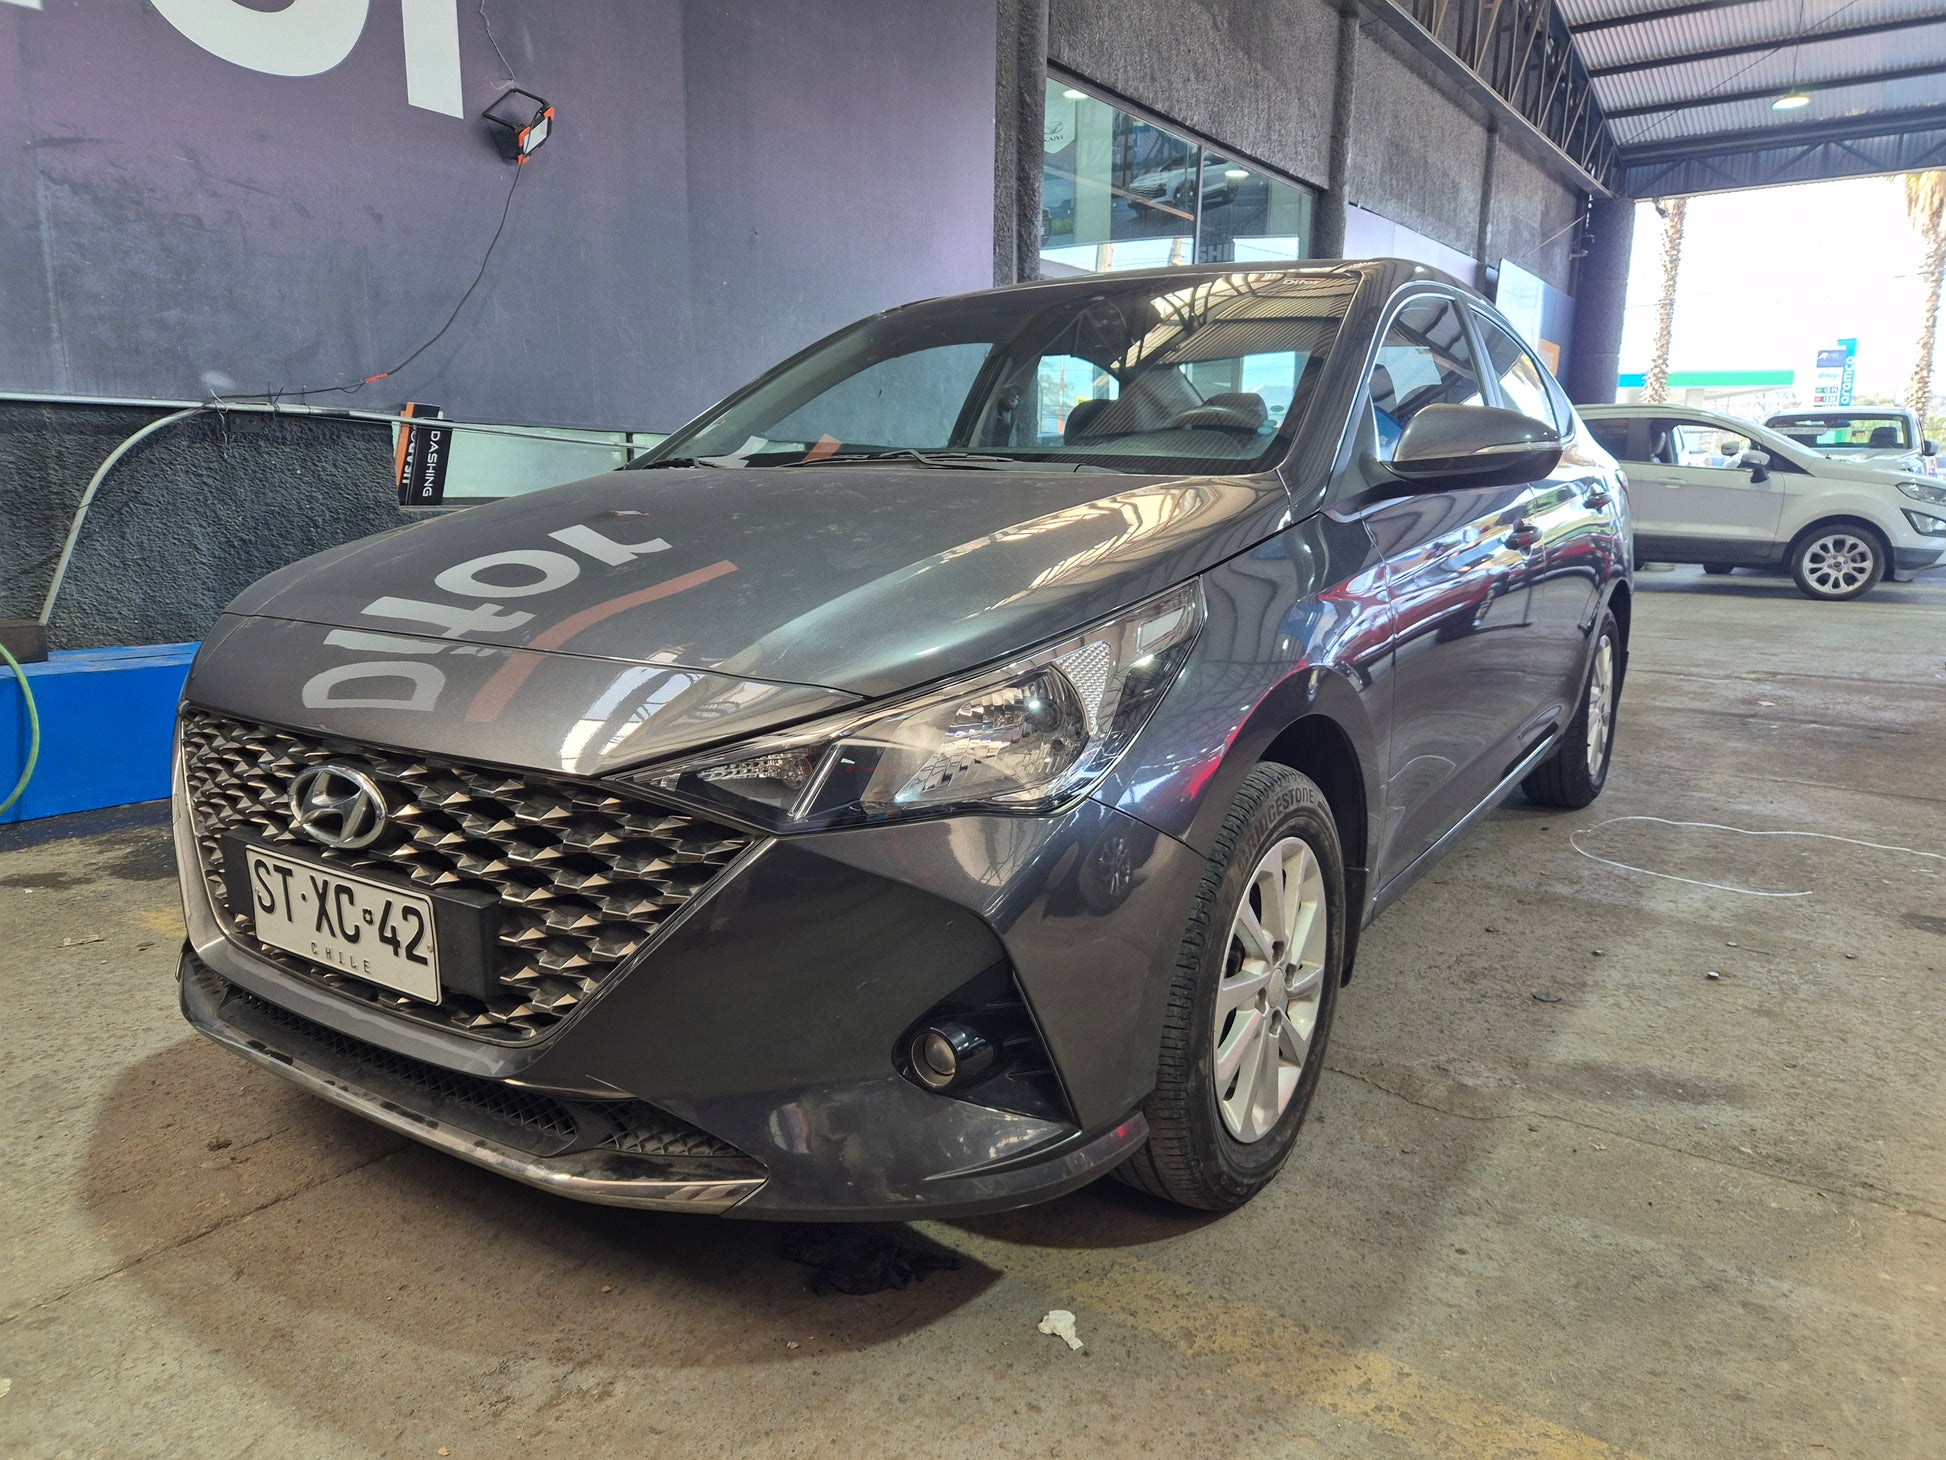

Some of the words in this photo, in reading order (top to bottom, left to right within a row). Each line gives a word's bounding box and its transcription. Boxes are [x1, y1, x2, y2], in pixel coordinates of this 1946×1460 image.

[1841, 355, 1855, 404] aramco
[422, 431, 441, 497] DASHING
[311, 942, 371, 974] CHILE
